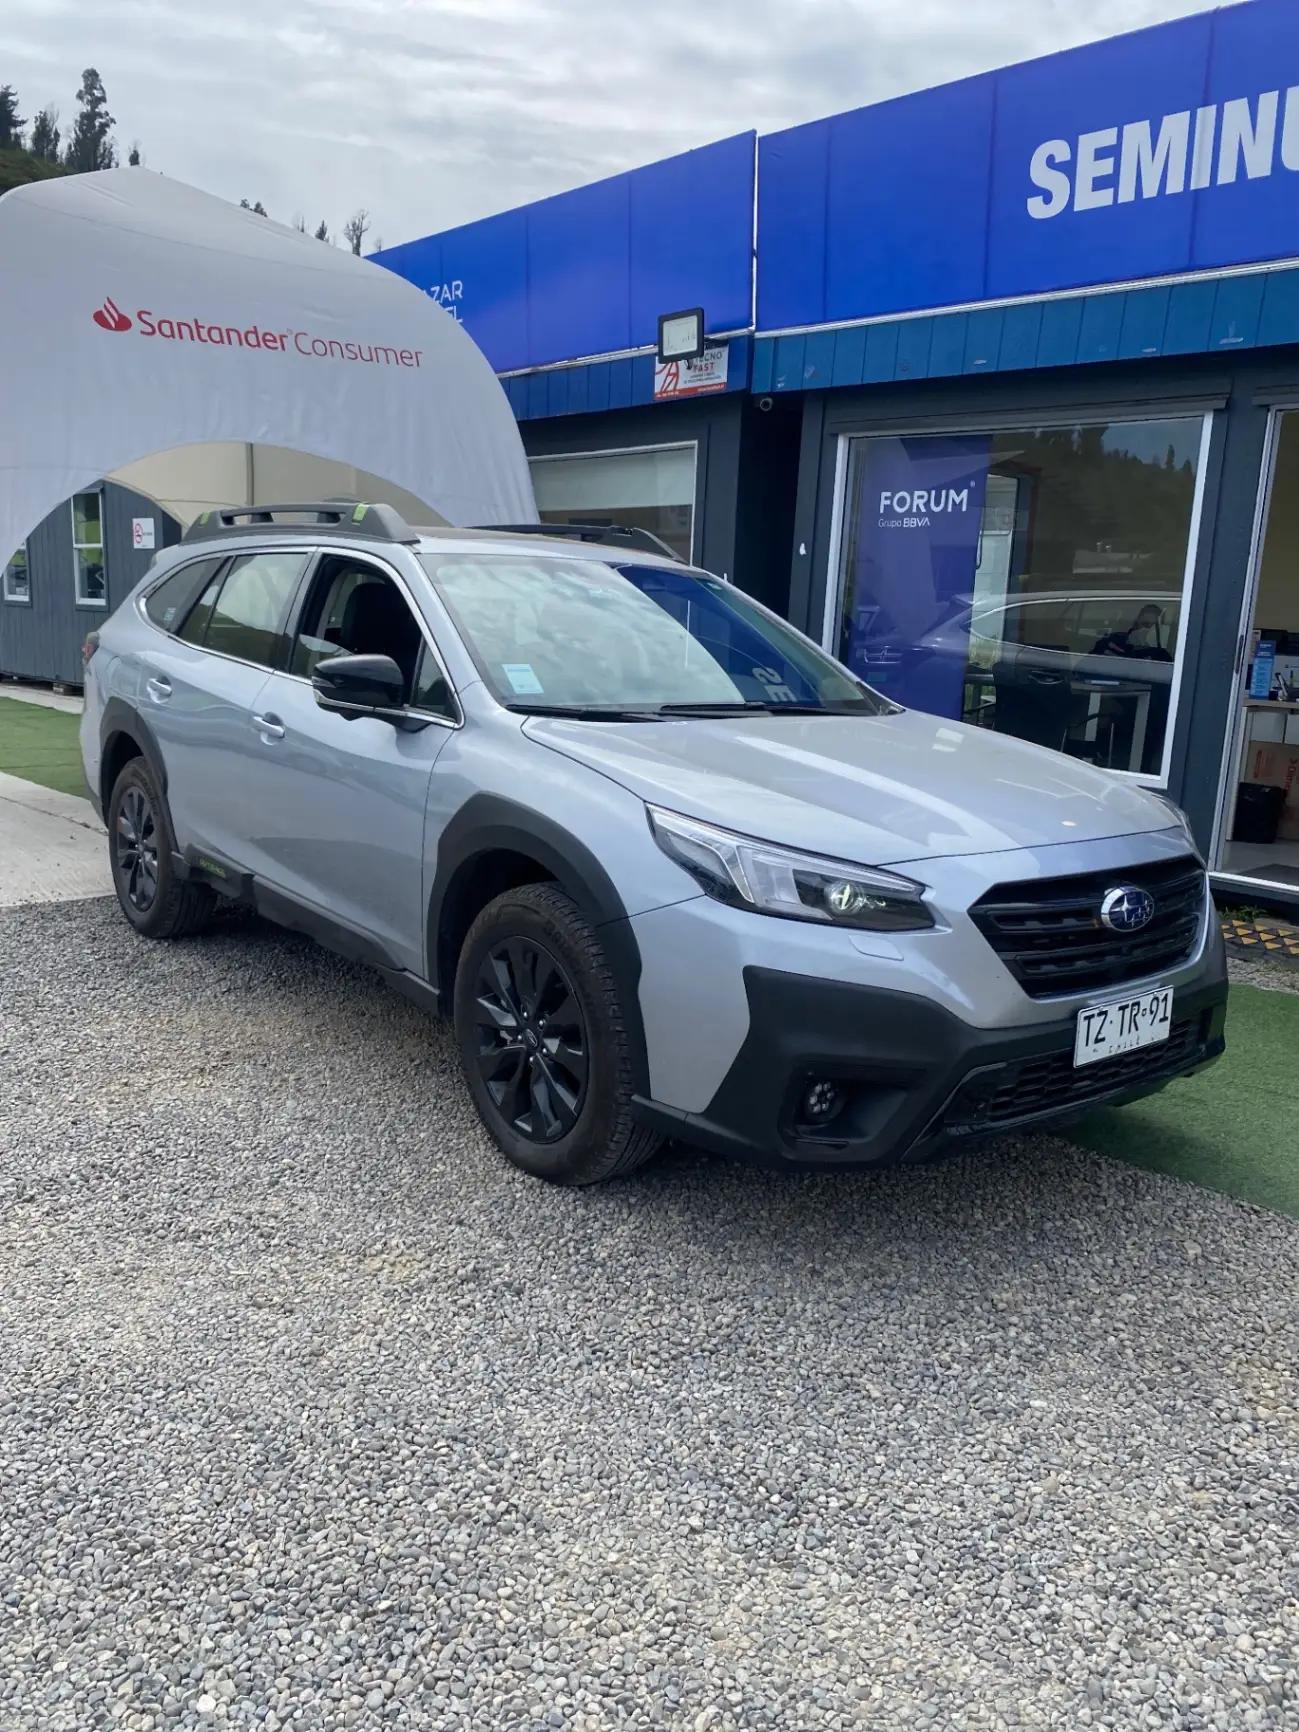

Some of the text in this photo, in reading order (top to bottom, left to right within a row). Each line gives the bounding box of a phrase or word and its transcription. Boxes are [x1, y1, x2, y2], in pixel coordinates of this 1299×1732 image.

[137, 310, 423, 367] Santander Consumer
[880, 489, 968, 513] FORUM
[878, 517, 930, 529] Grupo BBVA
